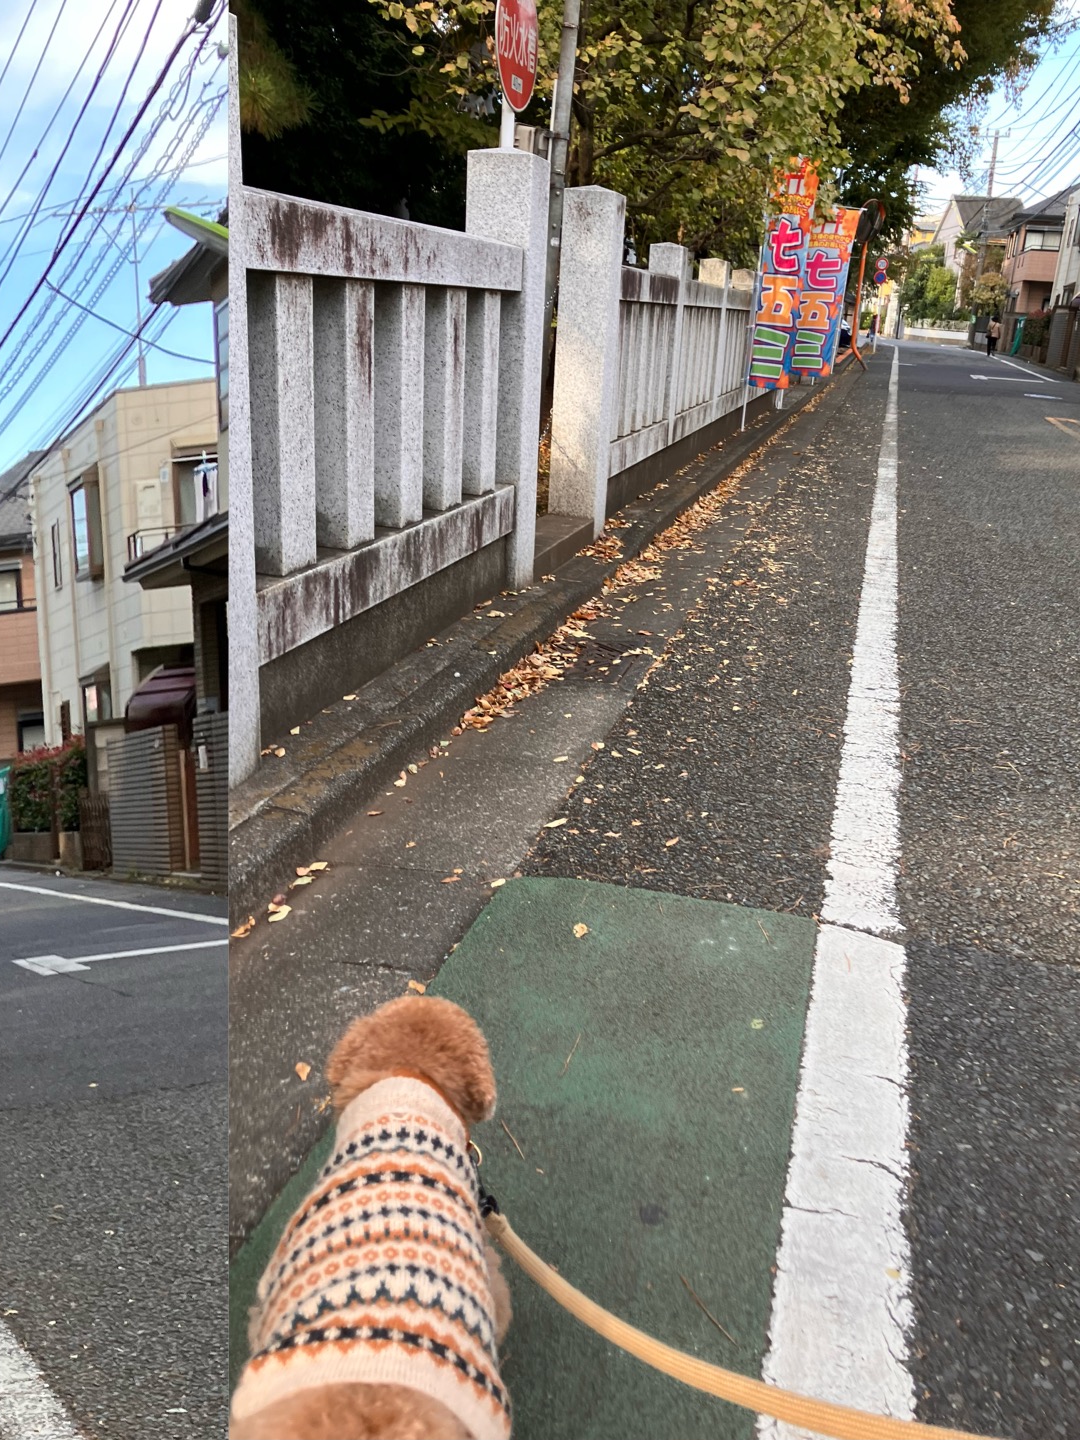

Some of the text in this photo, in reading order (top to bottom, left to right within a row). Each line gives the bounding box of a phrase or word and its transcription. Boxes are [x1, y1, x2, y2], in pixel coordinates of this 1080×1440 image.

[750, 217, 802, 380] 七五三
[791, 250, 842, 369] 七五三
